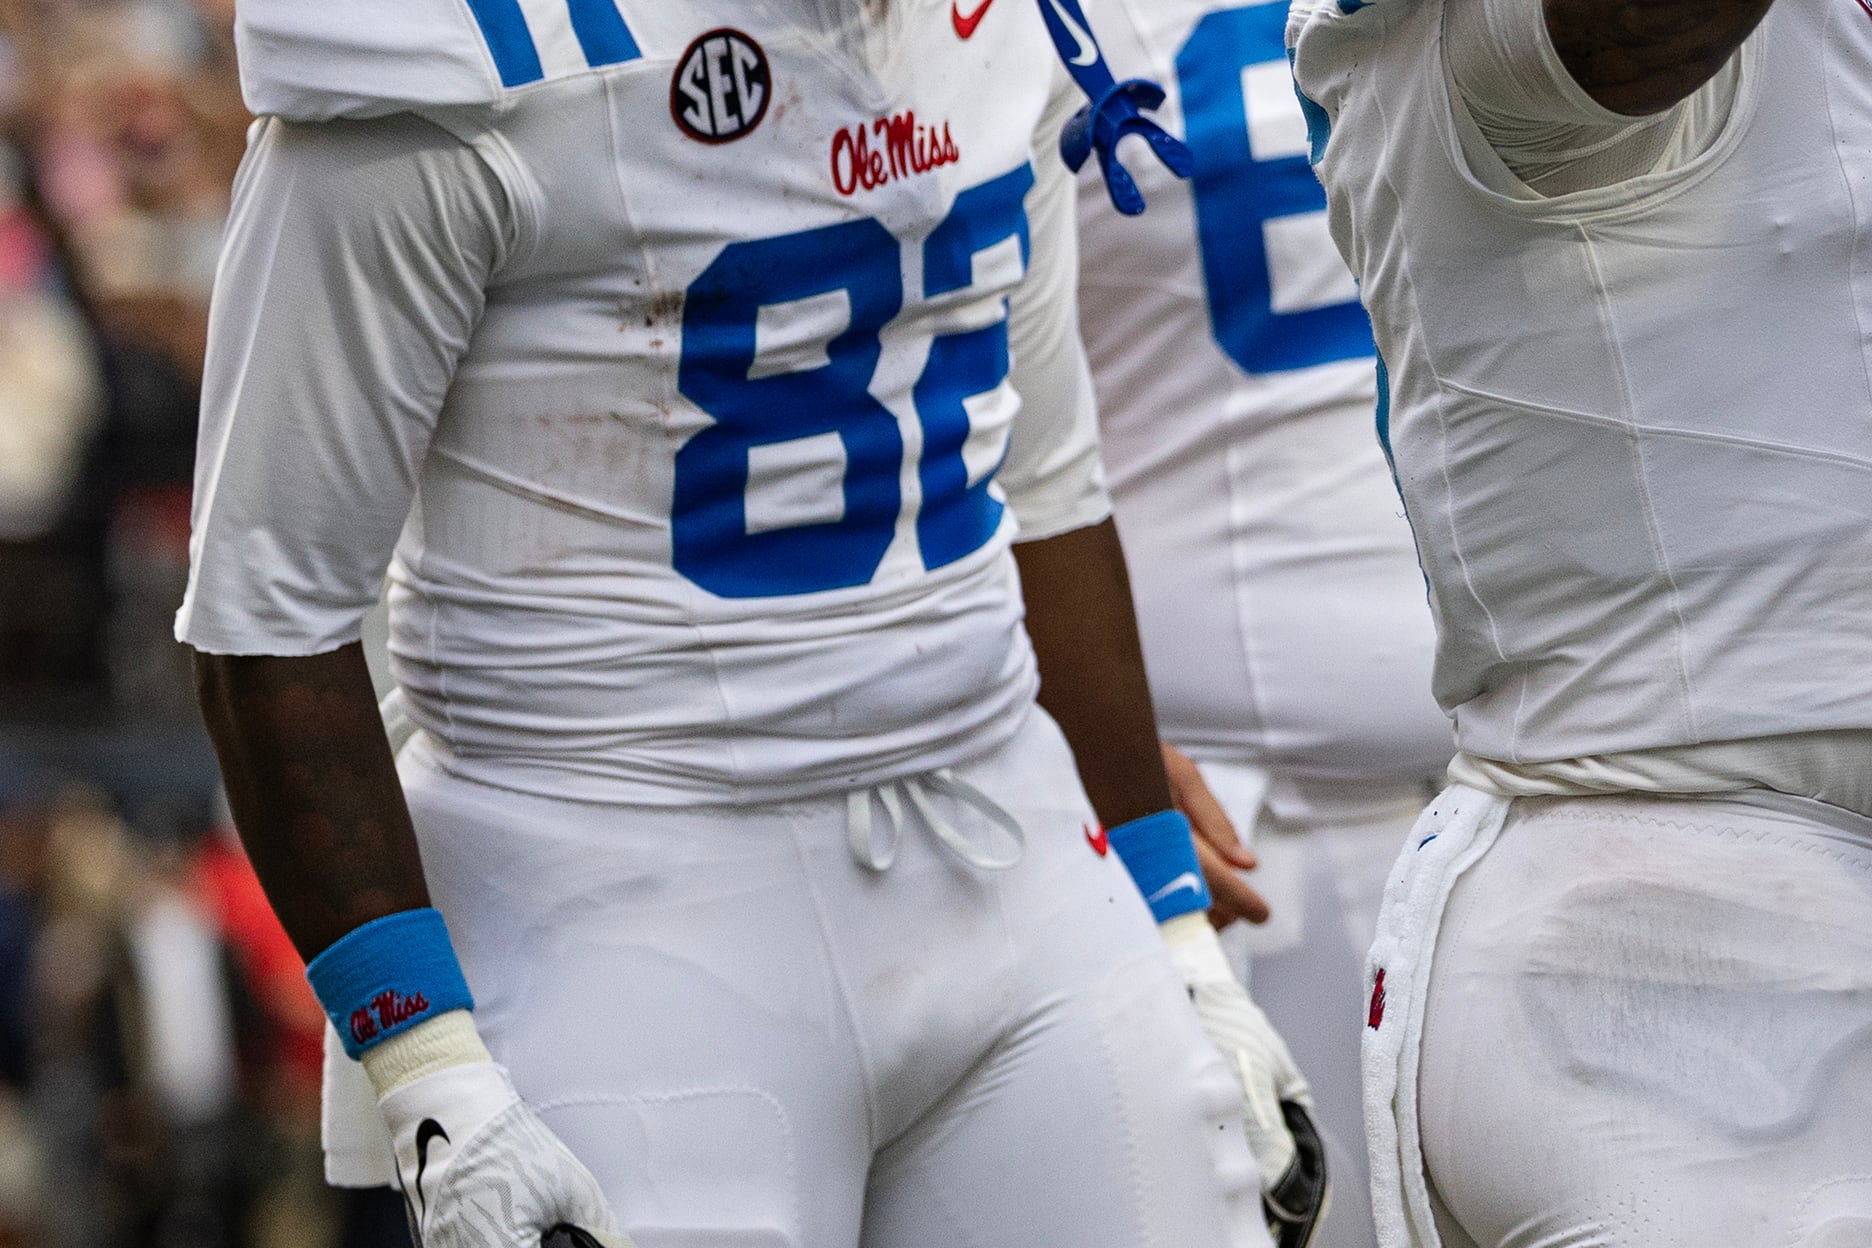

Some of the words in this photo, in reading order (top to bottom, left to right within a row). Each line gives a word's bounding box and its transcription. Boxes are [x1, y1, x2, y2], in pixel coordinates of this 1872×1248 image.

[679, 36, 765, 137] SEC
[832, 128, 888, 195] Ole
[873, 110, 959, 181] Miss
[672, 159, 1034, 599] 82
[370, 989, 430, 1028] Miss
